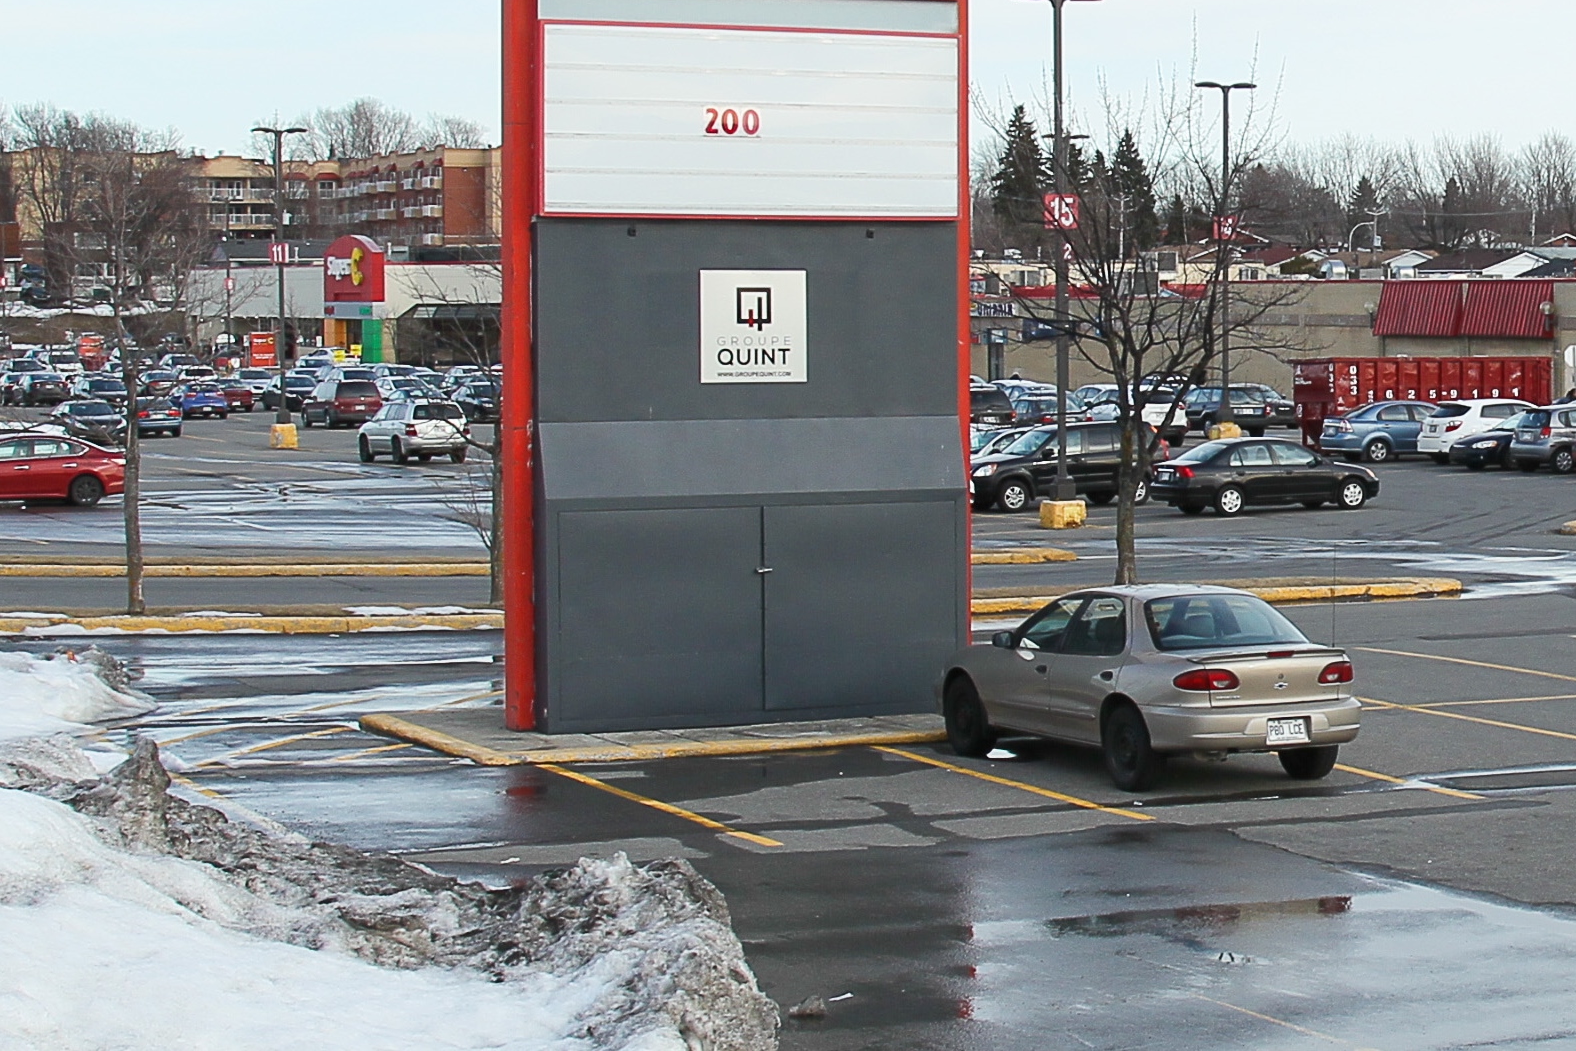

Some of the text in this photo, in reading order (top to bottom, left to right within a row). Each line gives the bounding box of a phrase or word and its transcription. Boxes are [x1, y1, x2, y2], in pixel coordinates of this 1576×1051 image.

[704, 107, 761, 135] 200
[1050, 197, 1073, 227] 15
[716, 335, 791, 346] GROUPE
[717, 348, 791, 366] QUINT
